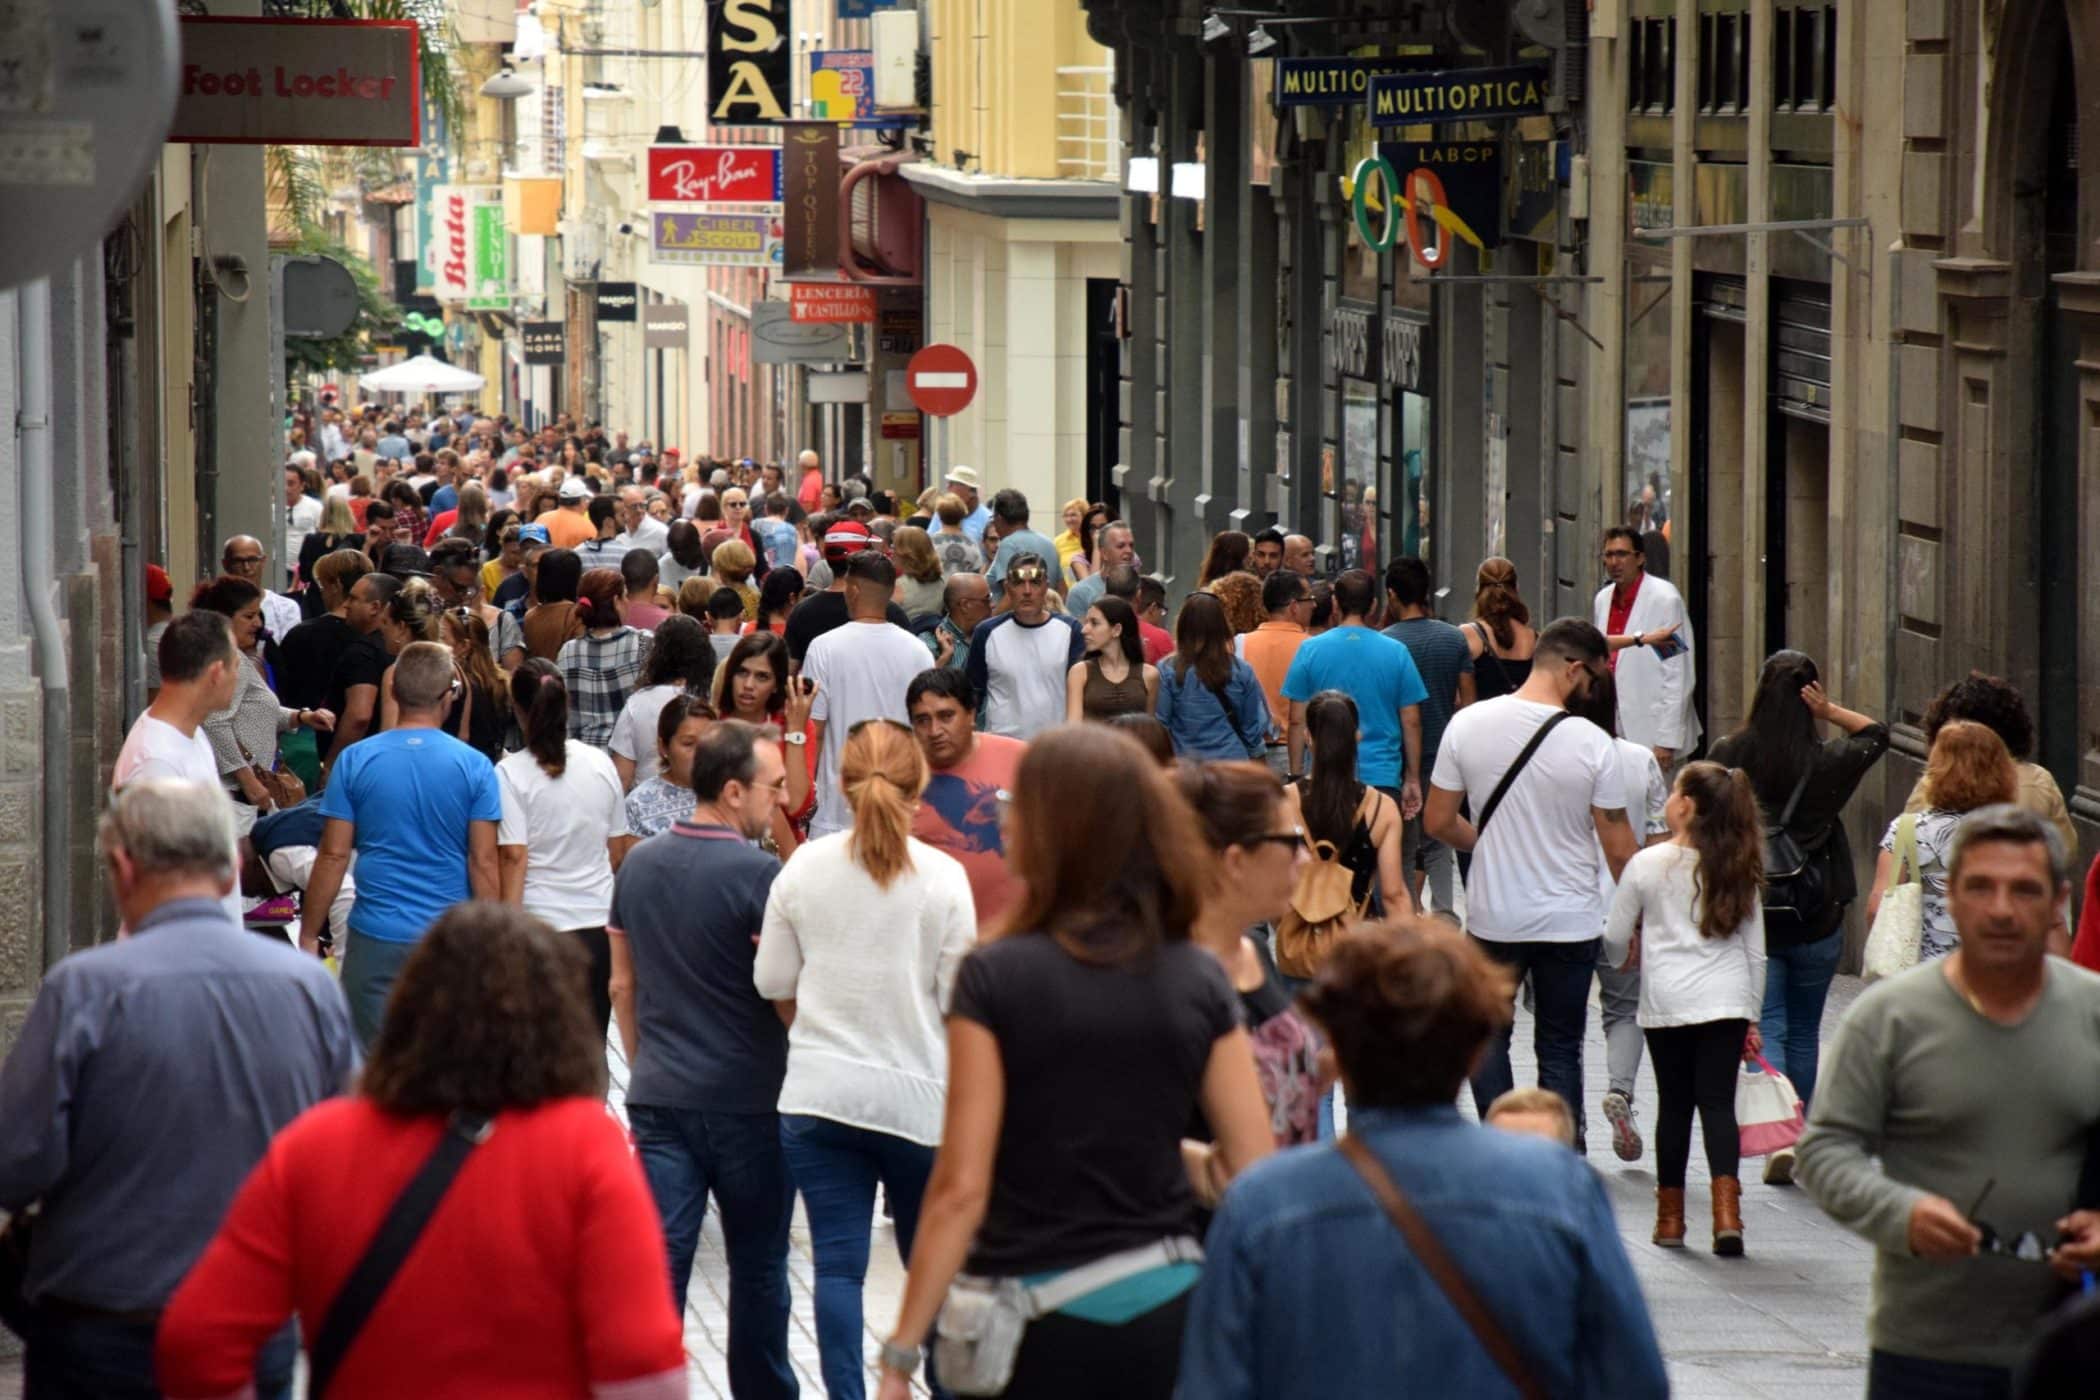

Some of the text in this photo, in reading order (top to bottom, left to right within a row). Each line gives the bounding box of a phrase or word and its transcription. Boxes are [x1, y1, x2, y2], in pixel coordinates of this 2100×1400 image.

[184, 64, 397, 100] Foot Locker
[839, 69, 865, 96] 22
[1284, 66, 1410, 94] MULTIO
[1376, 80, 1550, 115] MULTIOPTICAS
[660, 151, 757, 200] Ray-Ban
[696, 217, 756, 231] CIBER
[443, 196, 466, 289] Bata
[700, 232, 758, 247] SCOUT
[525, 334, 562, 343] ZARA
[525, 344, 562, 353] HOME
